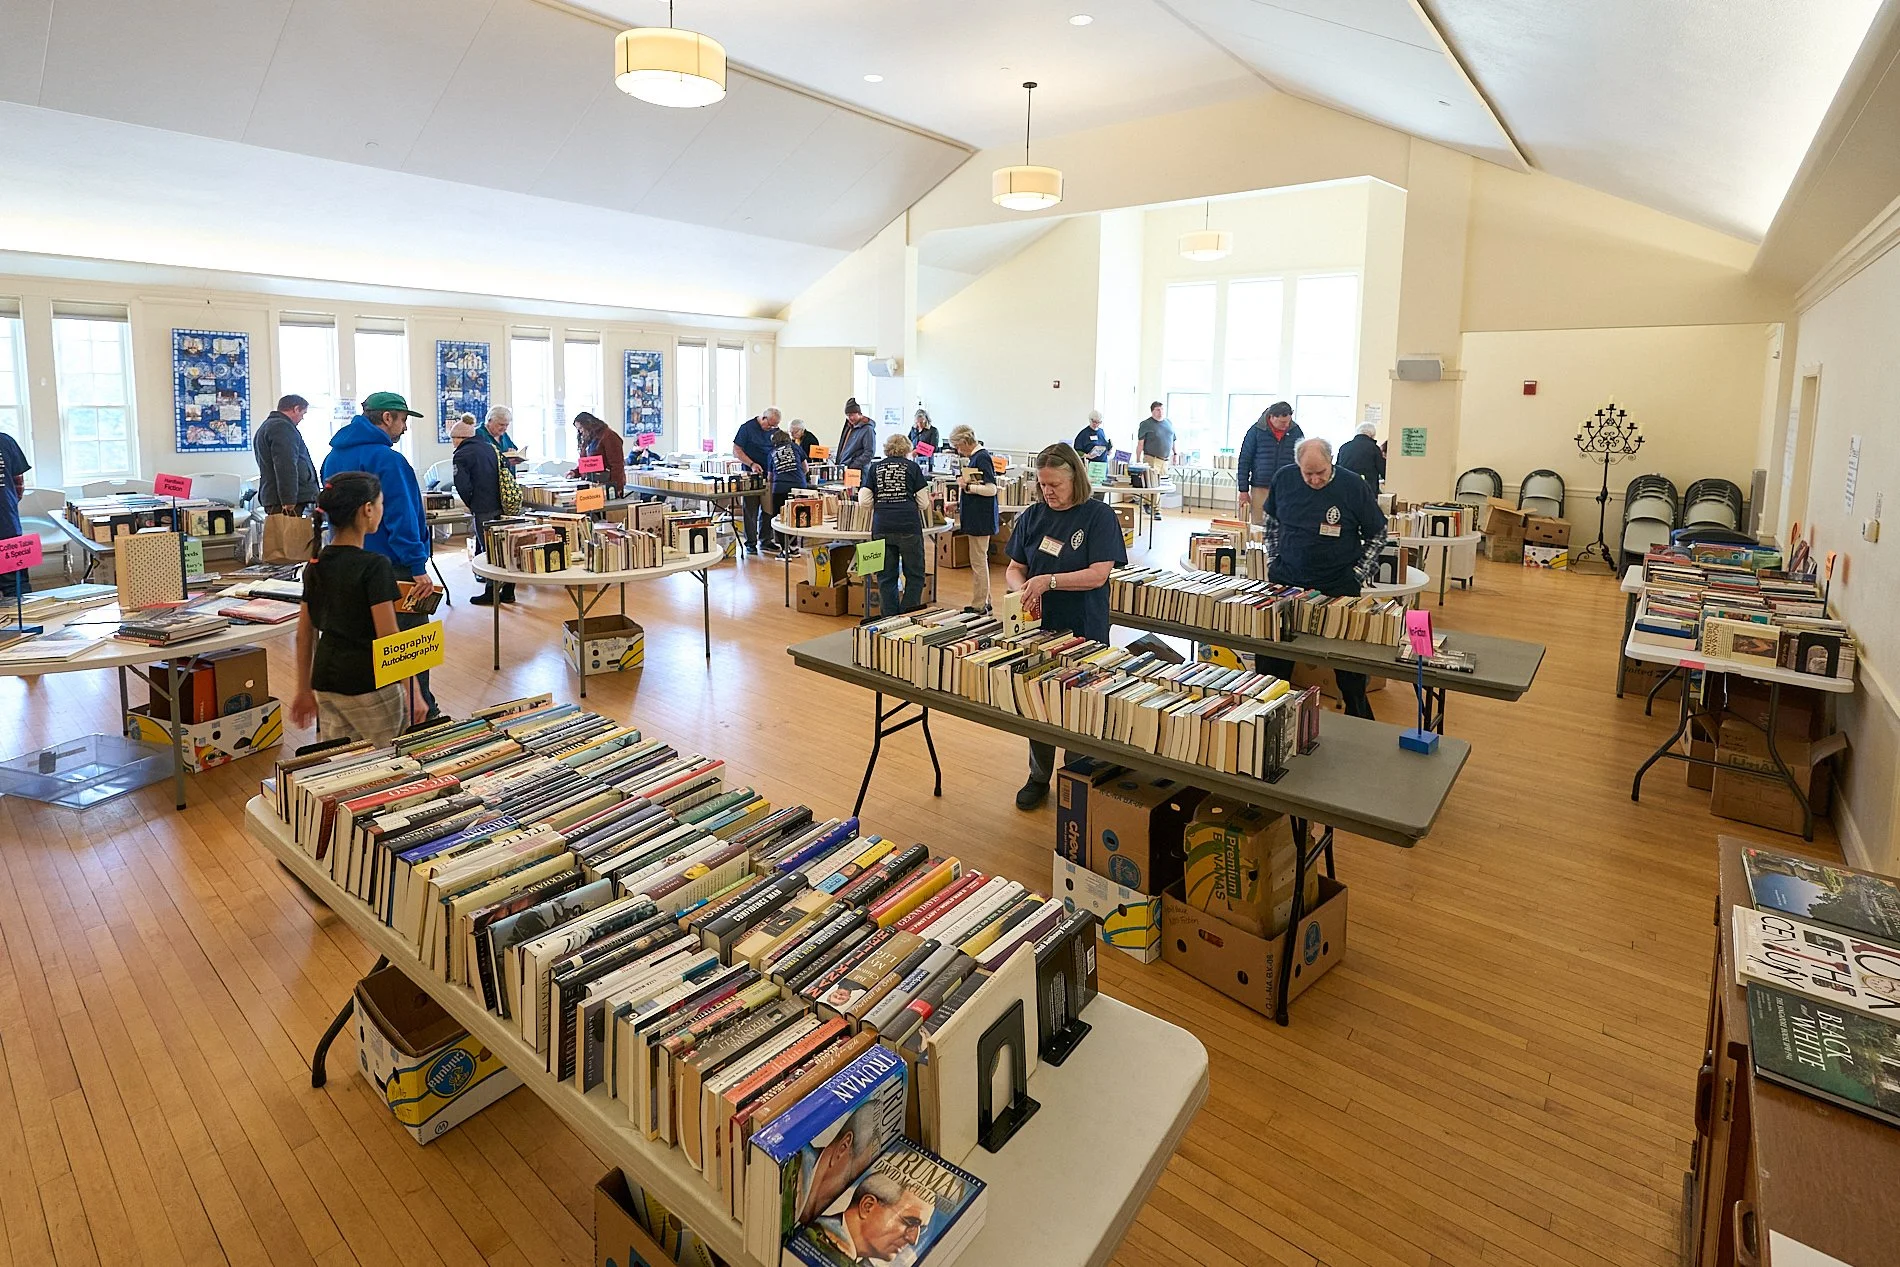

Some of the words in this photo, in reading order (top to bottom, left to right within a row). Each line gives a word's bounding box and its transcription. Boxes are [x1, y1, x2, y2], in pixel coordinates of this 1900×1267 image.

[164, 483, 183, 493] Fiction
[11, 547, 31, 558] Special
[383, 631, 437, 656] Biography/
[1703, 621, 1712, 656] CHRISTIANS
[1711, 622, 1719, 642] PAGANS
[381, 643, 440, 669] Autobiography
[1710, 643, 1718, 656] AND
[1730, 755, 1782, 773] U-HAU
[388, 773, 458, 798] PICASSO
[461, 815, 518, 841] TRUMAN
[896, 846, 921, 864] FRANKEN
[1212, 831, 1226, 900] BANANAS
[1227, 835, 1237, 895] Premium
[528, 870, 575, 893] BECKHAM
[698, 895, 742, 923] ROMNEY
[732, 895, 768, 922] CONFIDENCE
[767, 888, 783, 904] MAN
[897, 907, 921, 928] GEENA
[921, 895, 940, 912] DAVIS
[1020, 912, 1039, 929] MICHELLE
[1038, 903, 1053, 916] OBAMA
[913, 916, 925, 929] FIRST
[925, 909, 936, 922] LADY
[941, 923, 961, 941] OATH
[966, 904, 987, 922] HONOR
[1043, 927, 1062, 949] Anthony
[806, 929, 889, 998] MANKILLER
[811, 952, 830, 969] AVILA
[870, 959, 886, 970] My
[876, 950, 897, 963] Life
[855, 967, 879, 980] Clinton
[941, 964, 961, 983] NOOR
[541, 969, 549, 1036] GRAHAM
[852, 987, 877, 1013] Portrait
[587, 1015, 595, 1061] Katherine
[718, 1016, 767, 1051] ROOSEVELT
[732, 1021, 773, 1051] ELEANOR
[1791, 1015, 1826, 1071] WHITE
[1816, 1010, 1854, 1066] BLACK
[814, 1044, 839, 1065] BLOOD
[863, 1047, 881, 1063] DAVID
[426, 1050, 467, 1089] Chiquita
[831, 1053, 898, 1104] TRUMAN
[873, 1159, 900, 1182] DAVID
[899, 1136, 935, 1163] NATIONAL
[936, 1158, 984, 1189] BESTSELLER
[882, 1150, 969, 1204] TRUMAN
